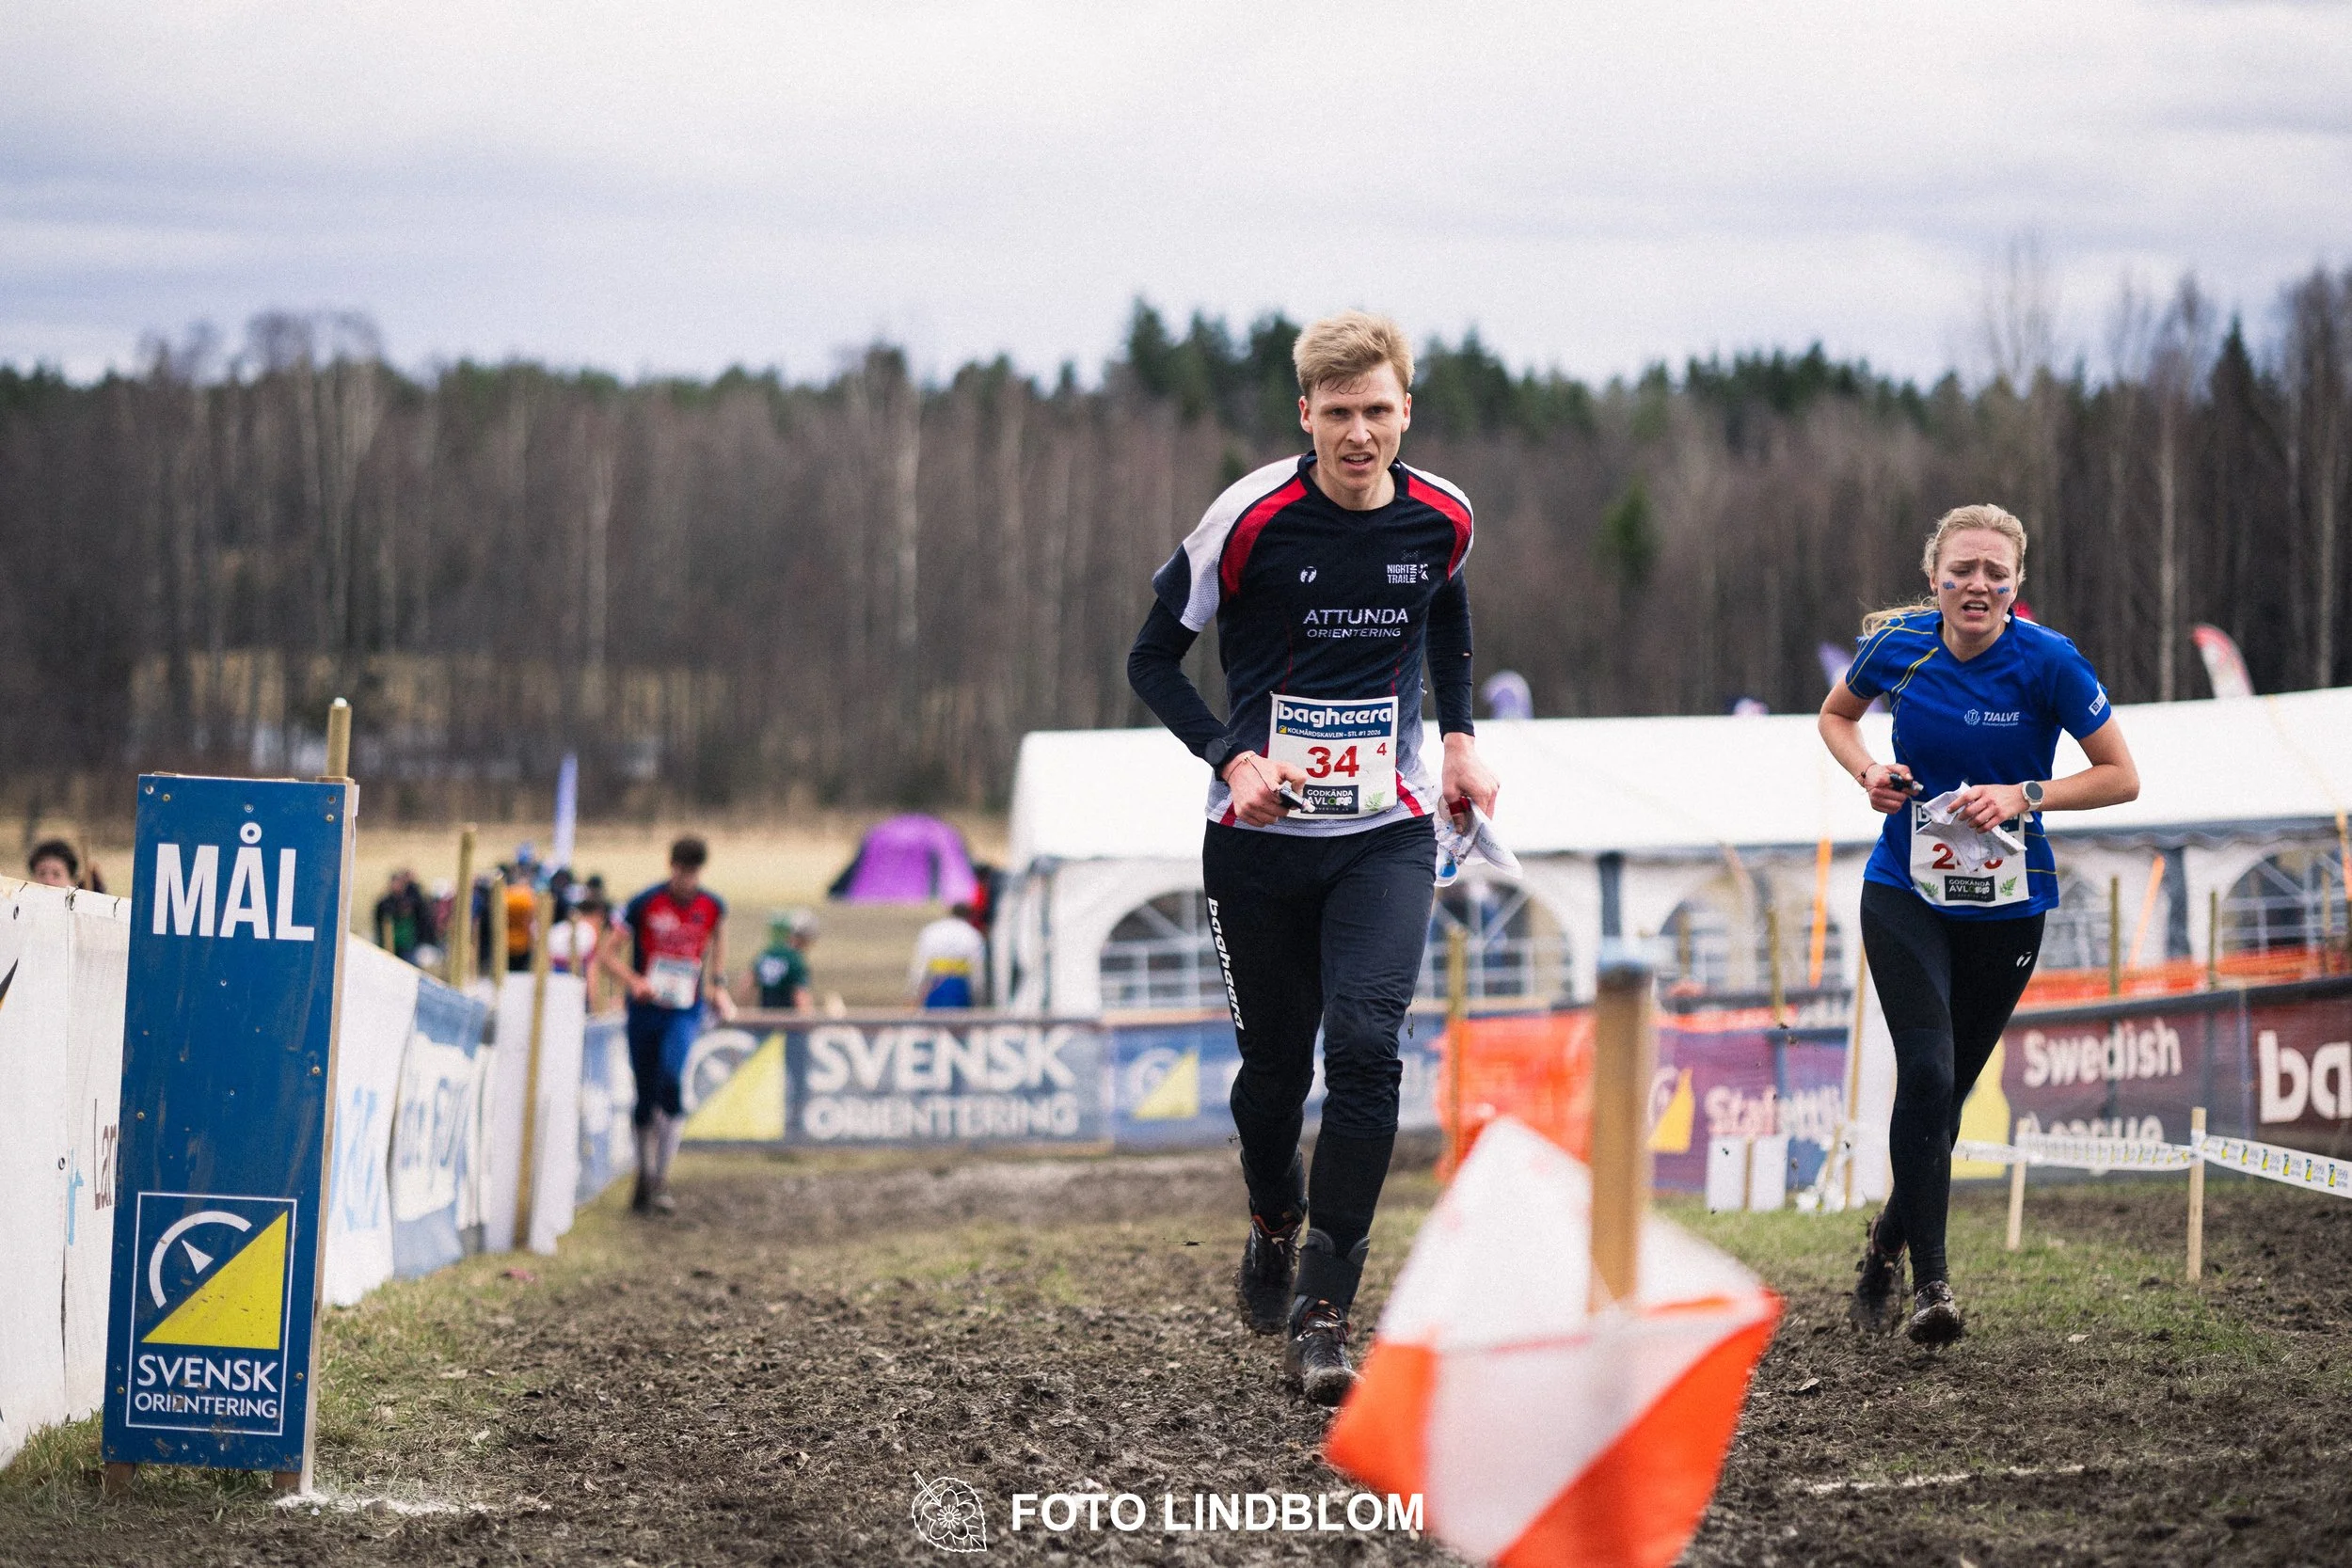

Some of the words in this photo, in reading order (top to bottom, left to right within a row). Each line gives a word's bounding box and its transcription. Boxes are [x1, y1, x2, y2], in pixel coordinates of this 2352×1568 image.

[1387, 564, 1409, 574] NIGHT
[1388, 574, 1410, 584] TRAIL
[1409, 564, 1418, 583] RUN
[1303, 608, 1408, 625] ATTUNDA
[1307, 627, 1401, 639] ORIENTERING
[1278, 702, 1392, 728] bagheera
[1984, 711, 2020, 722] TJALVE
[1287, 727, 1343, 738] KOLMÅRDSKAVLEN
[1376, 742, 1387, 756] 4
[1306, 746, 1359, 778] 34
[152, 822, 315, 941] MÅL
[806, 1024, 1077, 1092] SVENSK
[2024, 1017, 2183, 1088] Swedish
[803, 1091, 1080, 1140] ORIENTERING
[137, 1354, 278, 1392] SVENSK
[135, 1392, 277, 1419] ORIENTERING
